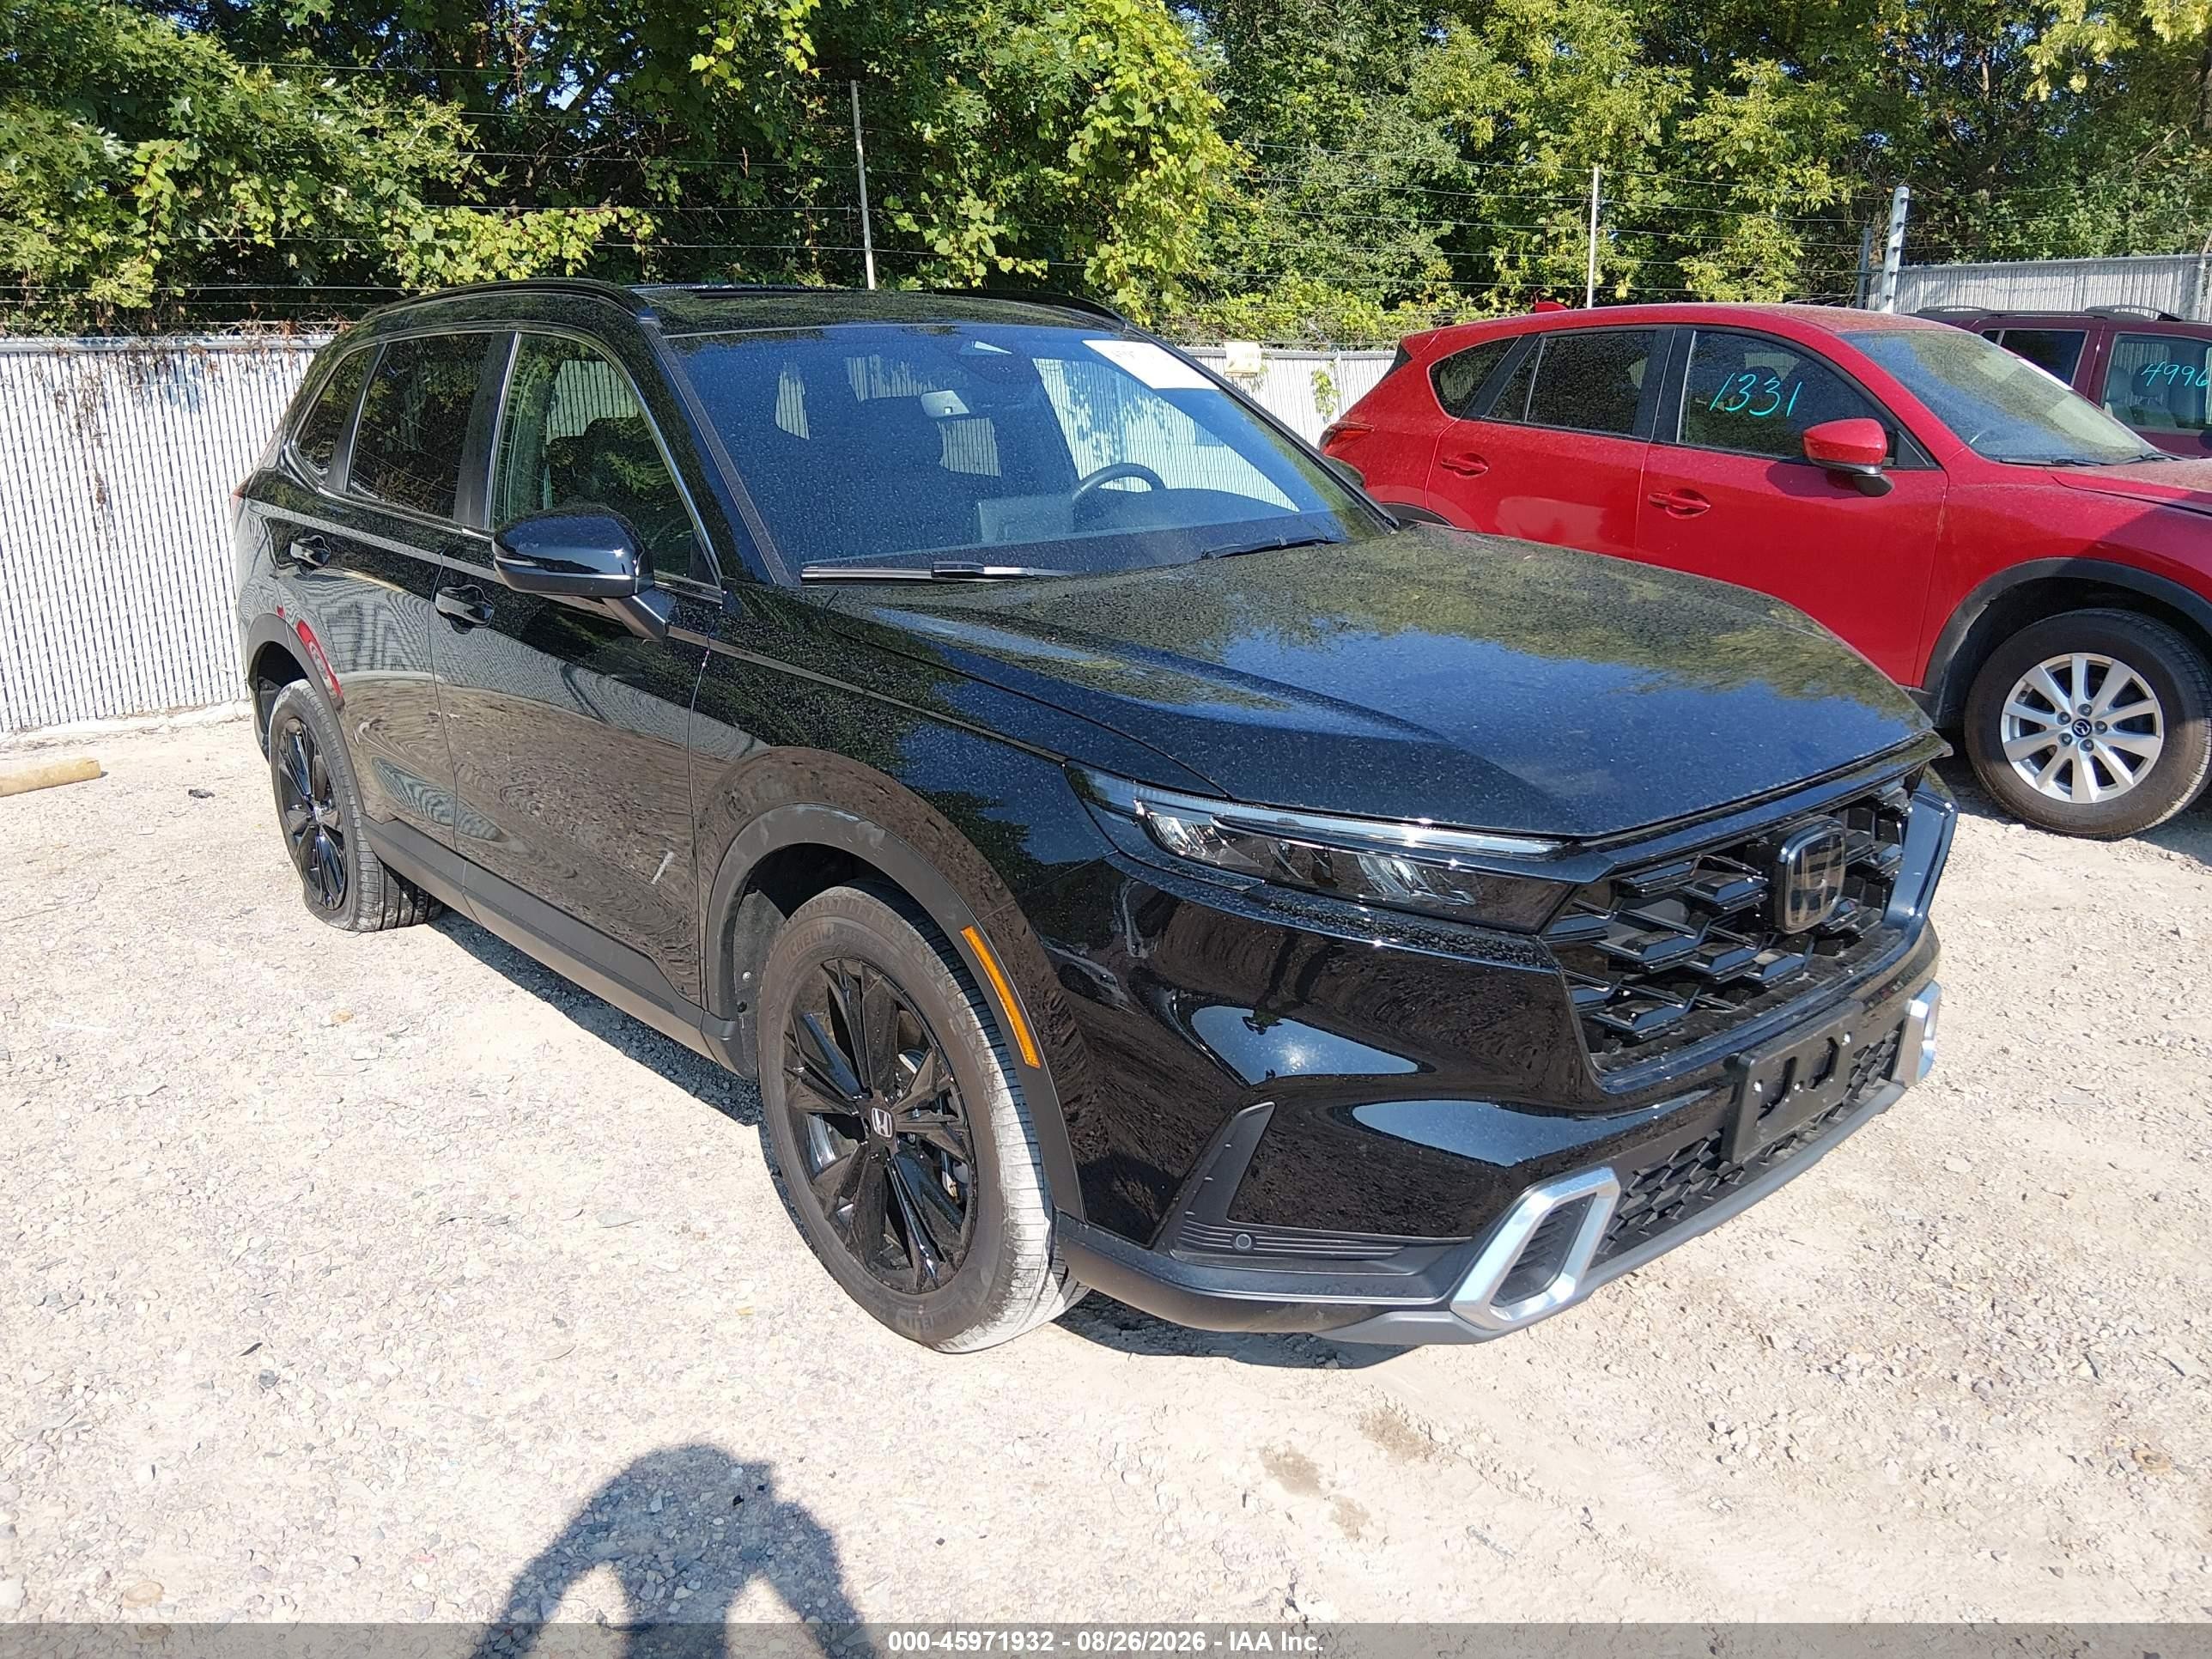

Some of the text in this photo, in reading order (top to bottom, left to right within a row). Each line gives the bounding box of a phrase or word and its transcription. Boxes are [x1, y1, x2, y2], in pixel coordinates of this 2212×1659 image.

[2140, 361, 2210, 387] 4996
[1709, 372, 1802, 418] 1331
[872, 1107, 892, 1138] H
